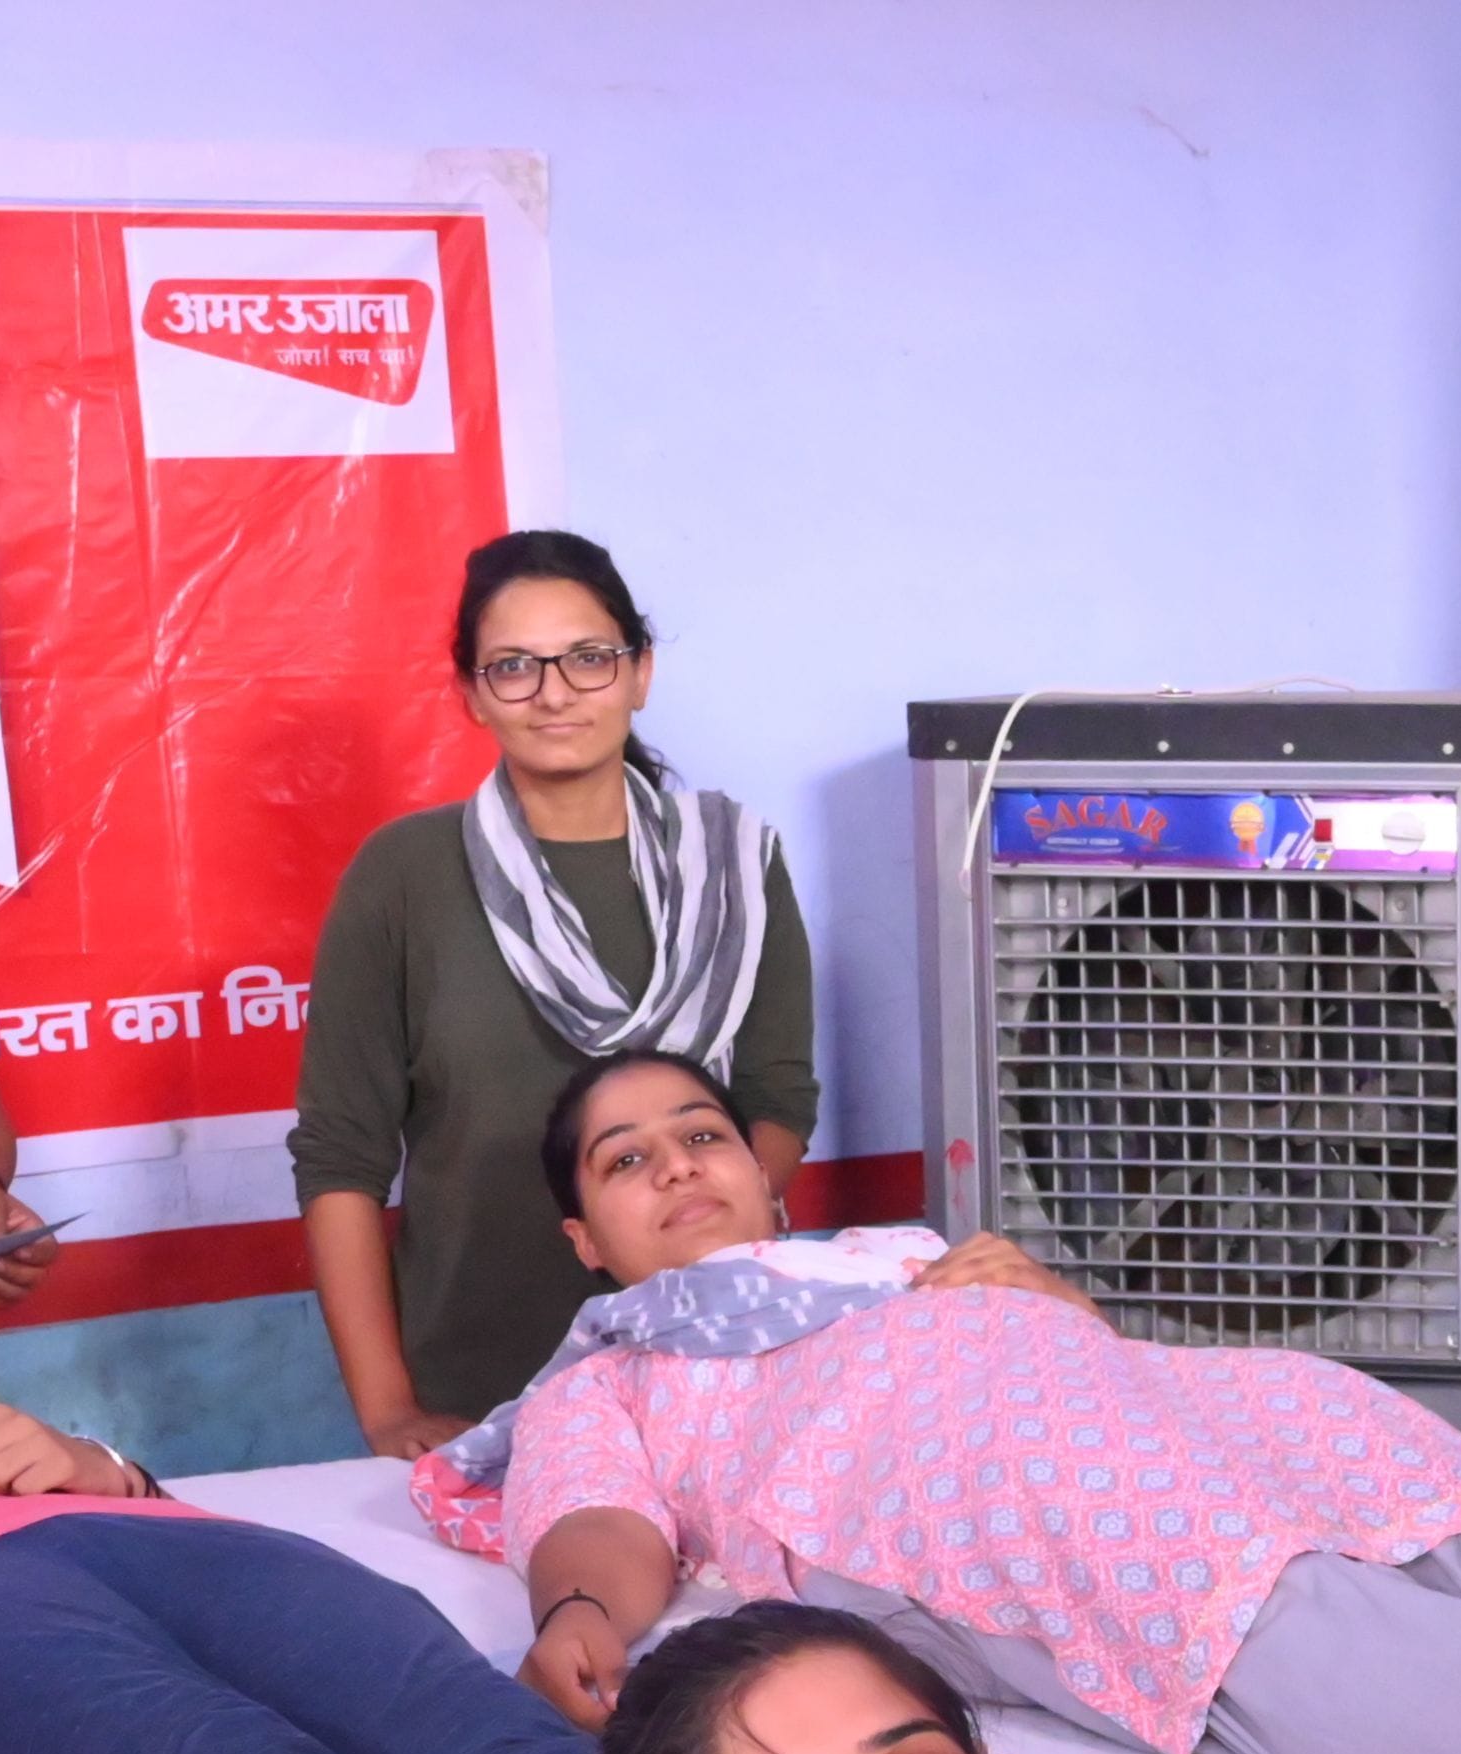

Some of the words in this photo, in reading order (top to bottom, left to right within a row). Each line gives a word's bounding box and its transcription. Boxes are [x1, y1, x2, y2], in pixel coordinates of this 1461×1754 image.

[164, 292, 274, 333] अमर
[276, 294, 409, 333] उजाला
[1025, 795, 1168, 844] SAGAR
[108, 992, 204, 1043] का
